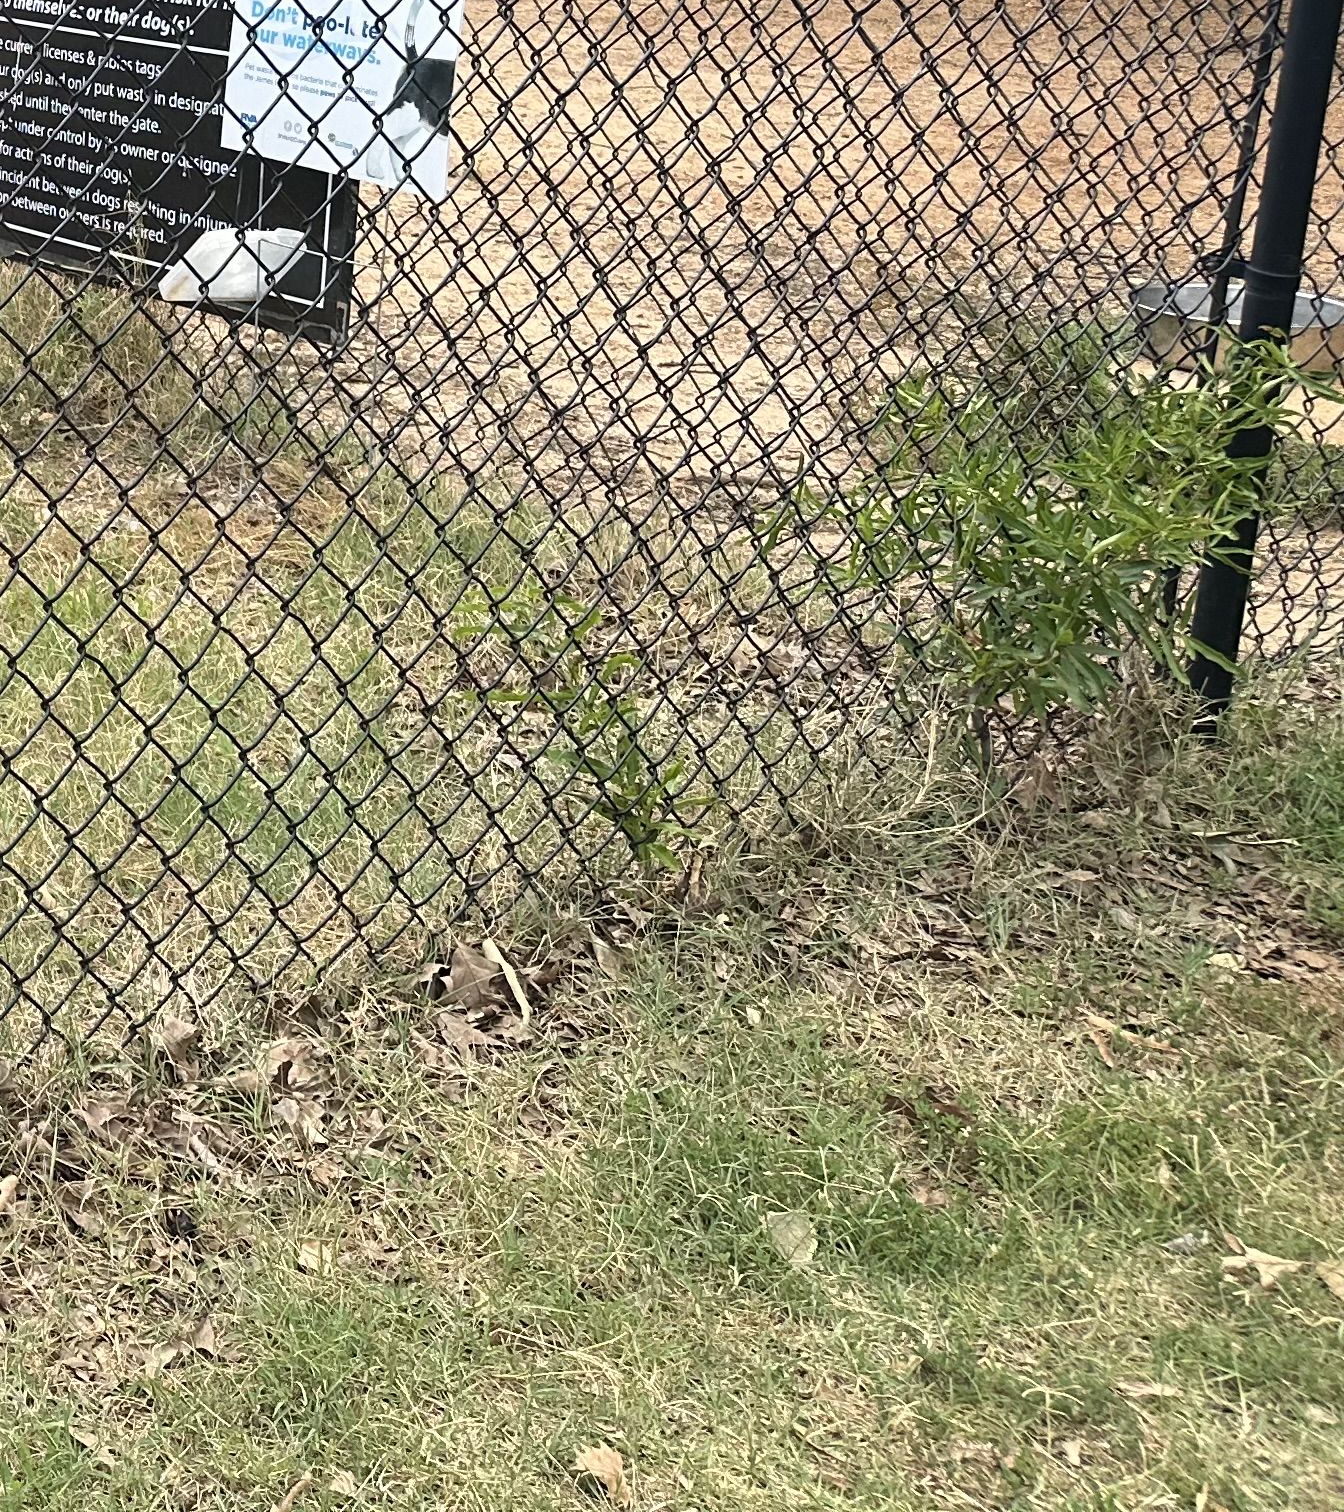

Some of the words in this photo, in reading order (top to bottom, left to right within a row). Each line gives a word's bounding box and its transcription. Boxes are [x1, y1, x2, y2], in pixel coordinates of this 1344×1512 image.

[86, 6, 103, 21] or
[104, 5, 139, 27] their
[140, 10, 195, 37] dog(s).
[302, 14, 382, 40] poo-lte
[4, 39, 34, 55] curre
[43, 42, 84, 64] licenses
[86, 50, 96, 66] &
[10, 65, 43, 86] dog(s)
[67, 75, 93, 96] only
[93, 82, 115, 98] put
[116, 85, 148, 104] wast
[153, 90, 166, 106] in
[25, 95, 49, 112] until
[77, 106, 107, 125] enter
[109, 109, 129, 127] the
[131, 117, 162, 134] gate.
[15, 119, 46, 138] under
[88, 132, 103, 154] by
[120, 143, 160, 162] owner
[161, 151, 176, 165] or
[15, 147, 52, 166] actins
[53, 153, 66, 169] of
[67, 155, 94, 174] their
[11, 191, 57, 217] between
[101, 214, 113, 230] is
[91, 188, 121, 211] dogs
[179, 207, 191, 225] in
